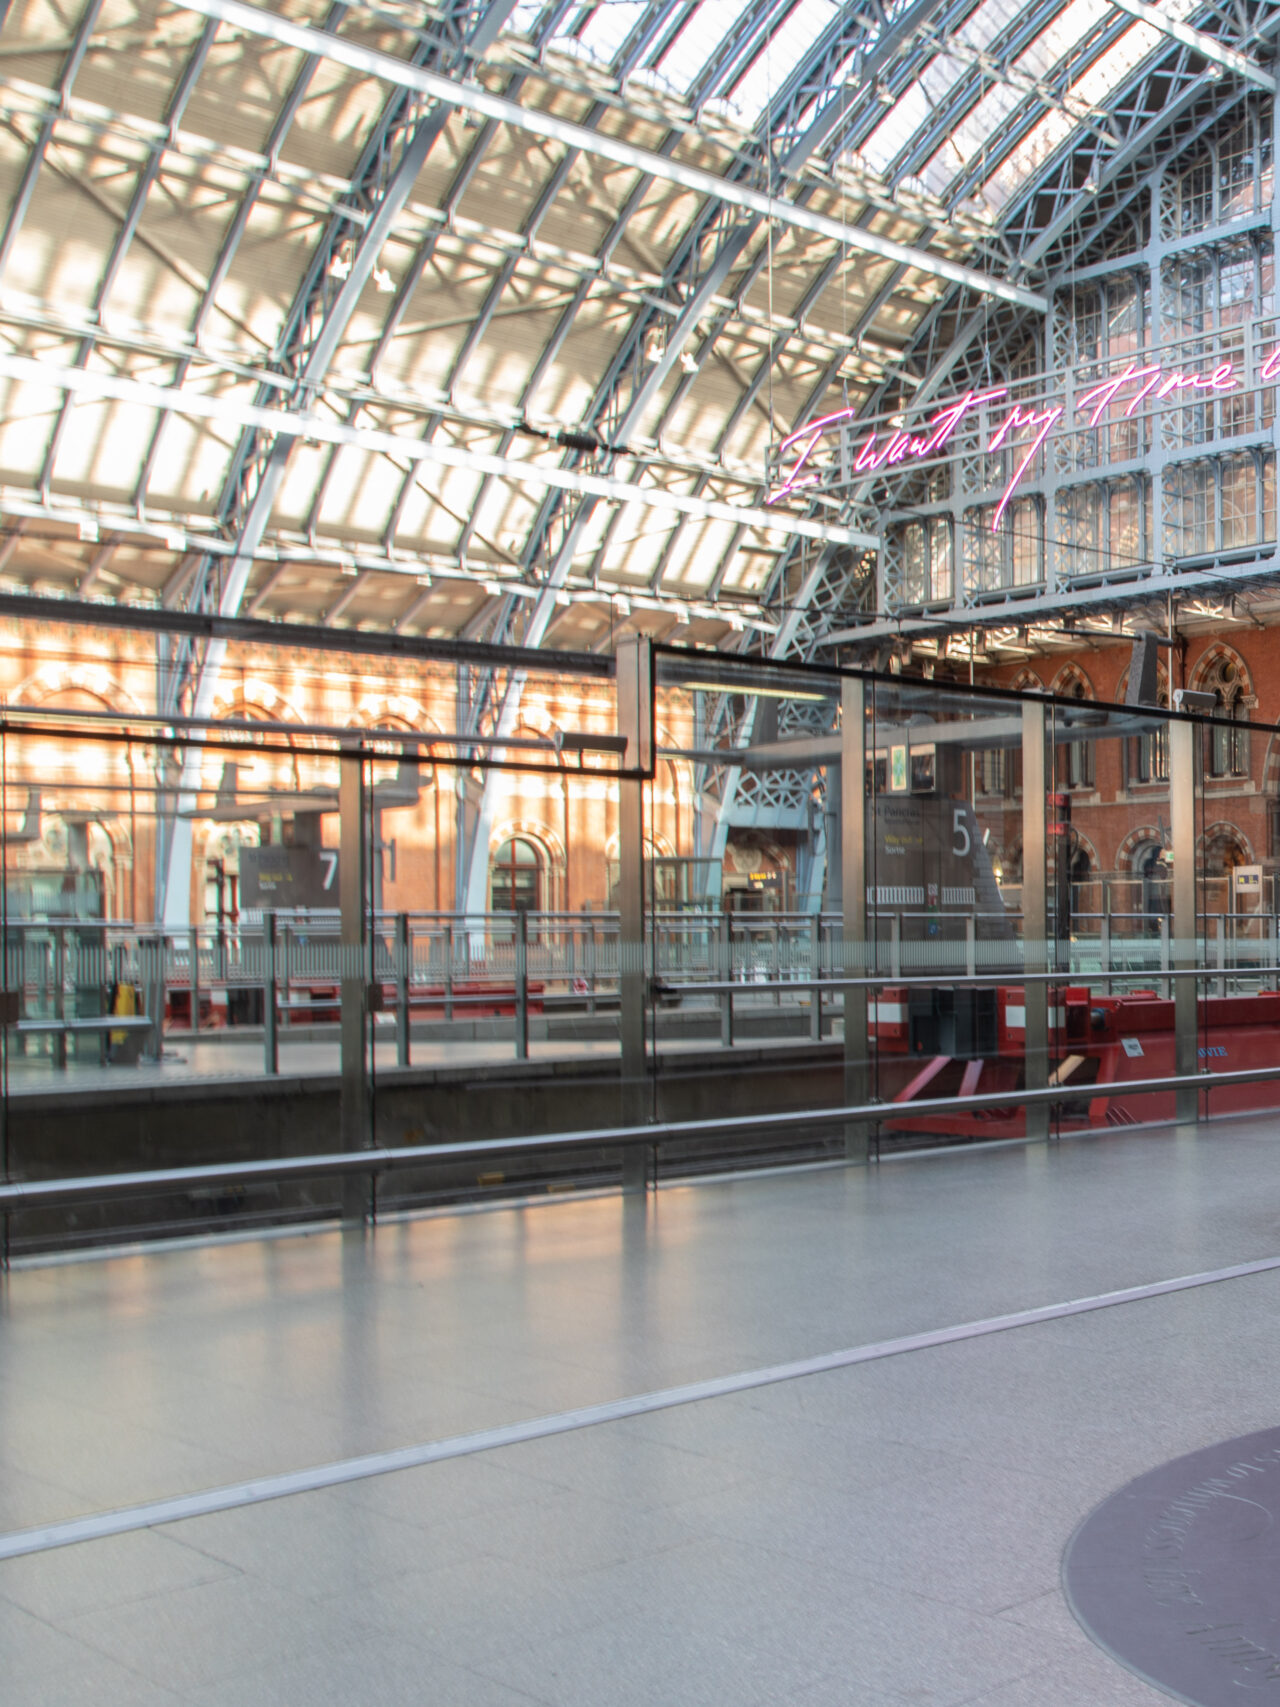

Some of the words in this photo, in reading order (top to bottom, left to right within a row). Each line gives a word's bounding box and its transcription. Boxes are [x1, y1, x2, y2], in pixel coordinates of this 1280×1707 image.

[767, 407, 856, 505] I
[986, 404, 1064, 534] my
[951, 807, 971, 857] 5
[318, 852, 338, 890] 7
